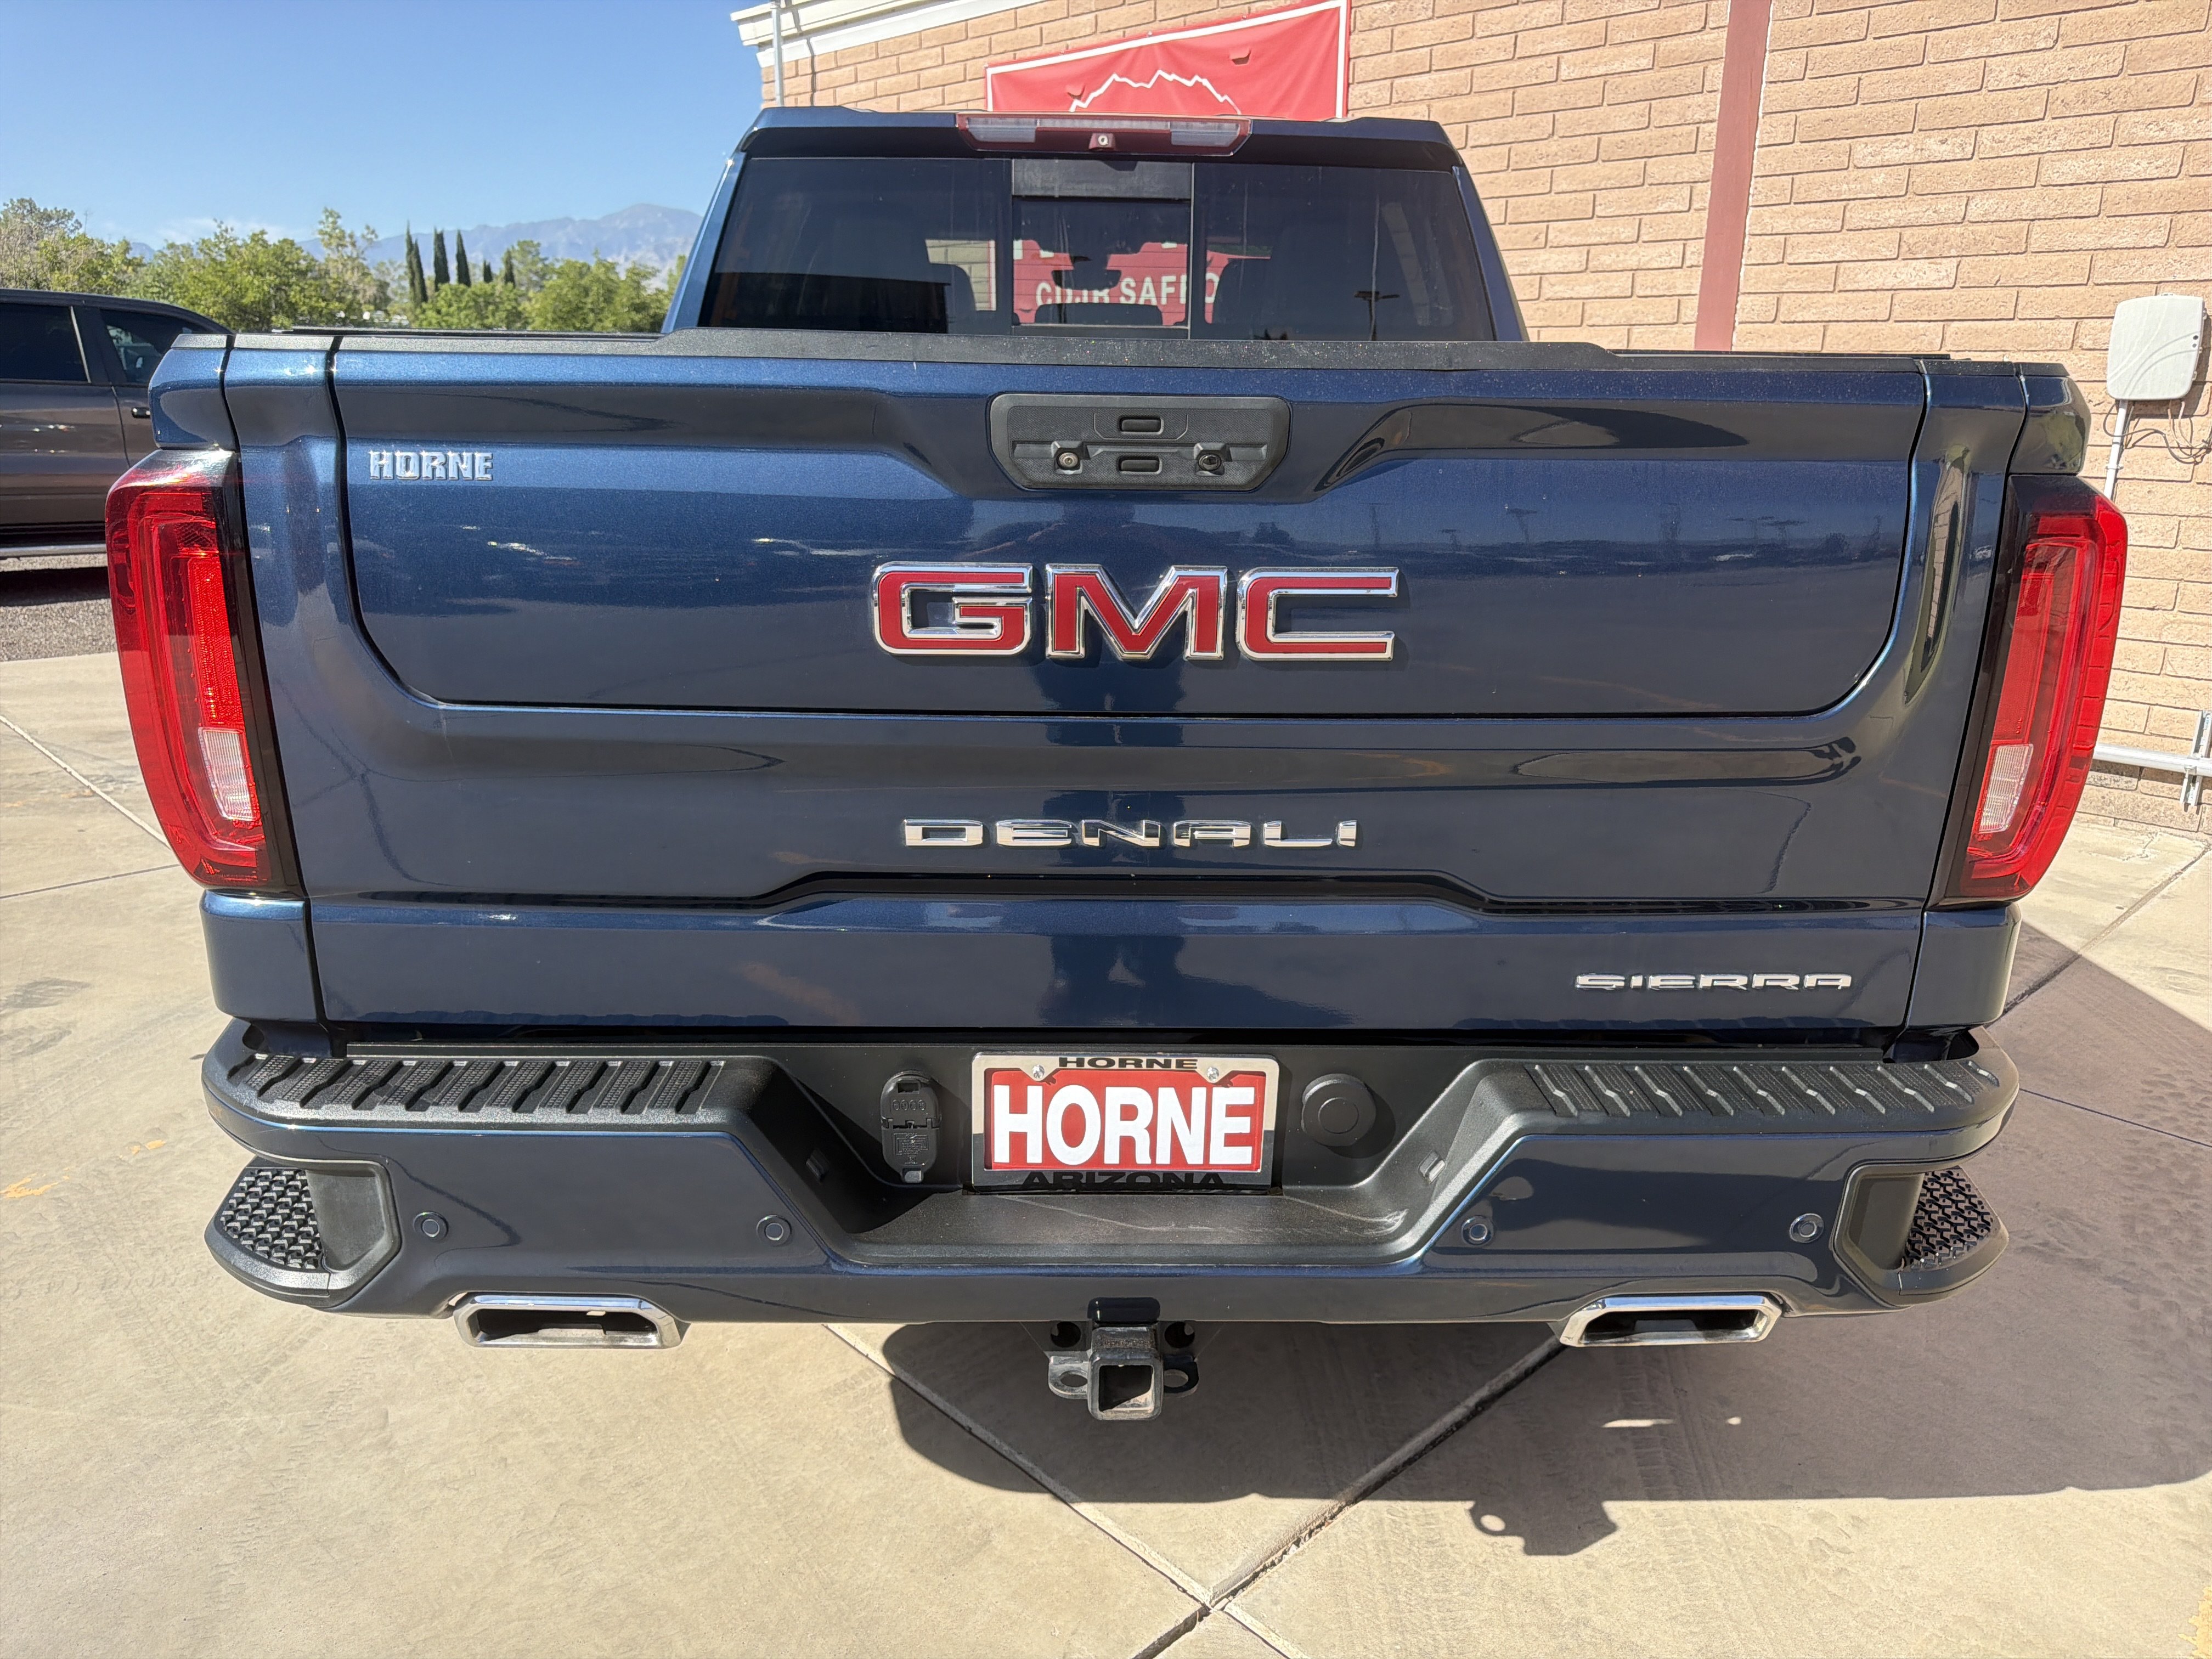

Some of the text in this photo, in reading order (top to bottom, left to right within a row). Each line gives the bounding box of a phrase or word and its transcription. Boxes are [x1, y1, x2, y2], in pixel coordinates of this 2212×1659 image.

[370, 451, 493, 480] HORNE
[872, 562, 1400, 659] GMC
[904, 819, 1358, 847] DENALI
[1576, 973, 1852, 990] SIERRA
[1058, 1057, 1198, 1069] HORNE
[993, 1084, 1255, 1166] HORNE
[1020, 1171, 1226, 1189] ARIZONA
